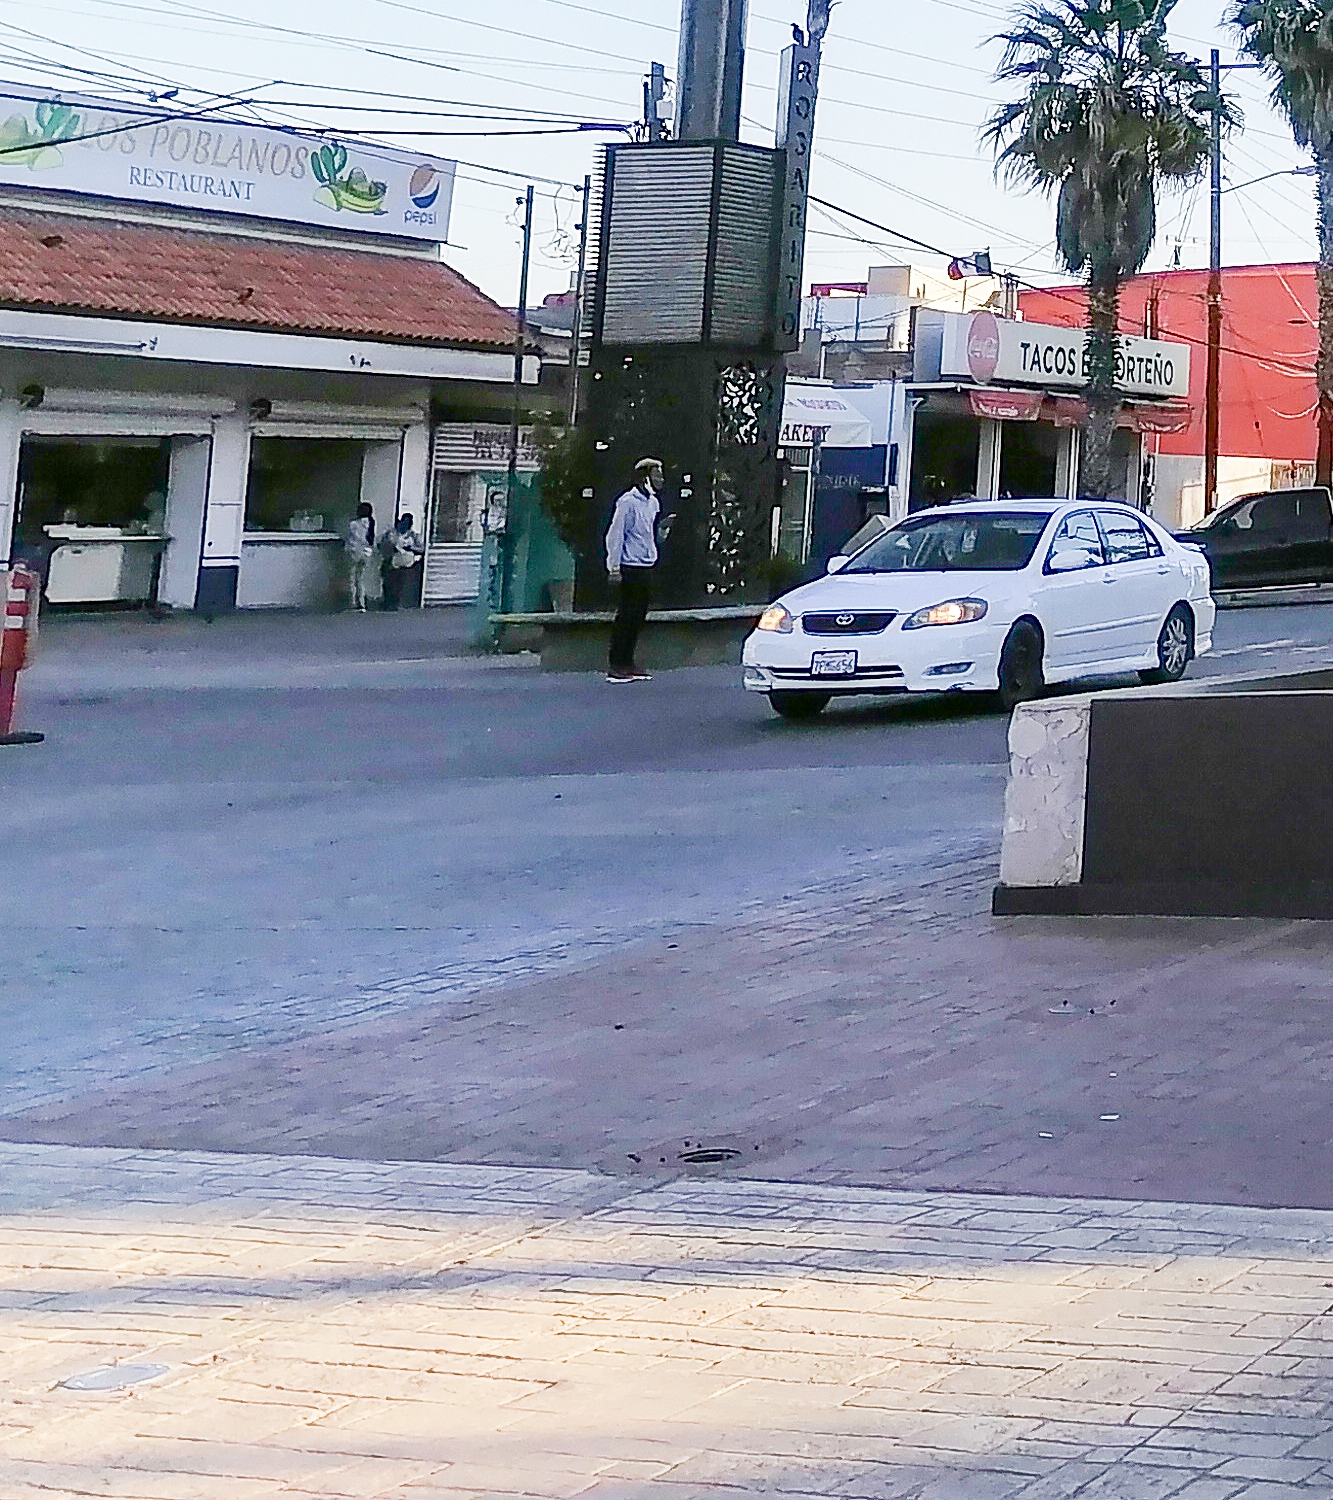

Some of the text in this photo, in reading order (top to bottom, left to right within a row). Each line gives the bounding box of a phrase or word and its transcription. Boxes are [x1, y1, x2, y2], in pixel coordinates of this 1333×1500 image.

[79, 112, 310, 179] LOS POBLANOS
[128, 165, 256, 201] RESTAURANT
[781, 59, 813, 337] ROSARITO
[403, 209, 438, 227] pepsi
[1020, 341, 1077, 378] TACOS
[1113, 351, 1175, 387] ORTEÑO
[780, 423, 831, 443] AKEY
